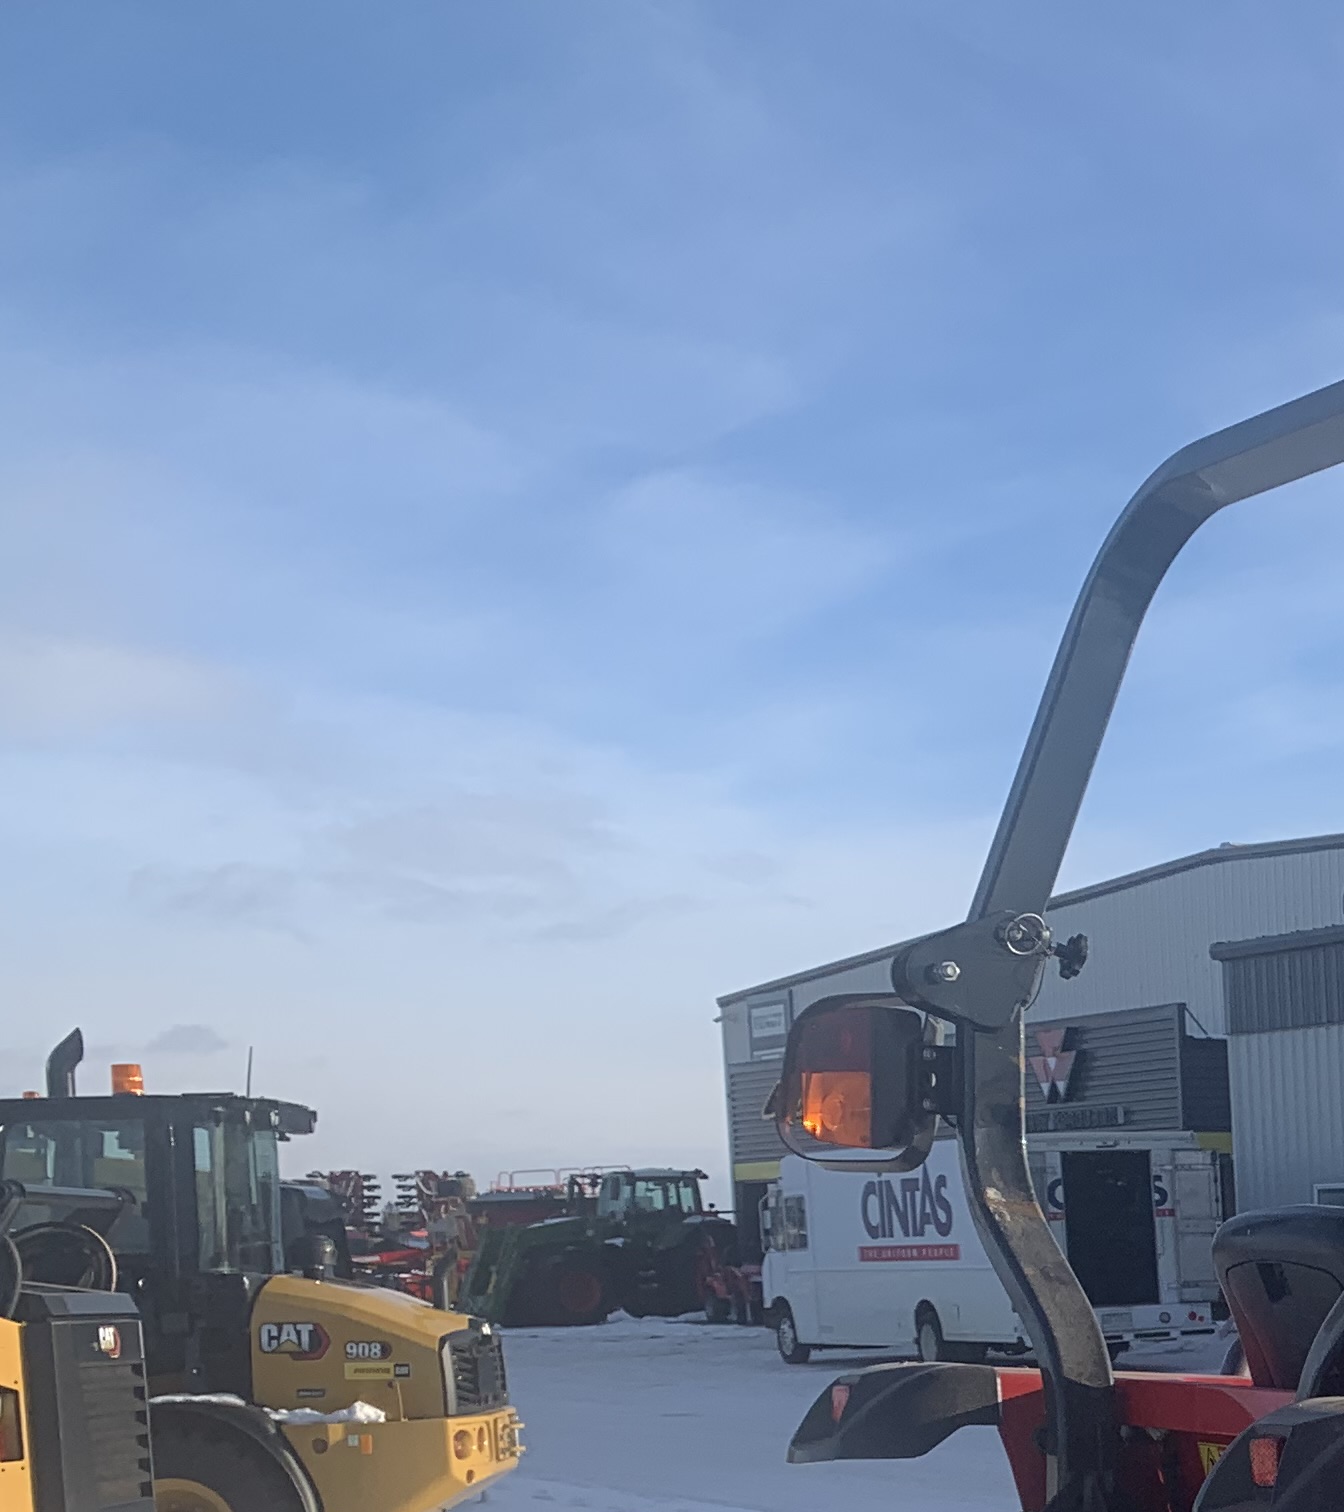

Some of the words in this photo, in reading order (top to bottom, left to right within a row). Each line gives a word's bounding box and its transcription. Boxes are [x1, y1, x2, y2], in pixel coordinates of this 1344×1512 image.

[861, 1161, 953, 1240] CINTAS
[260, 1323, 313, 1352] CAT
[345, 1342, 382, 1359] 908
